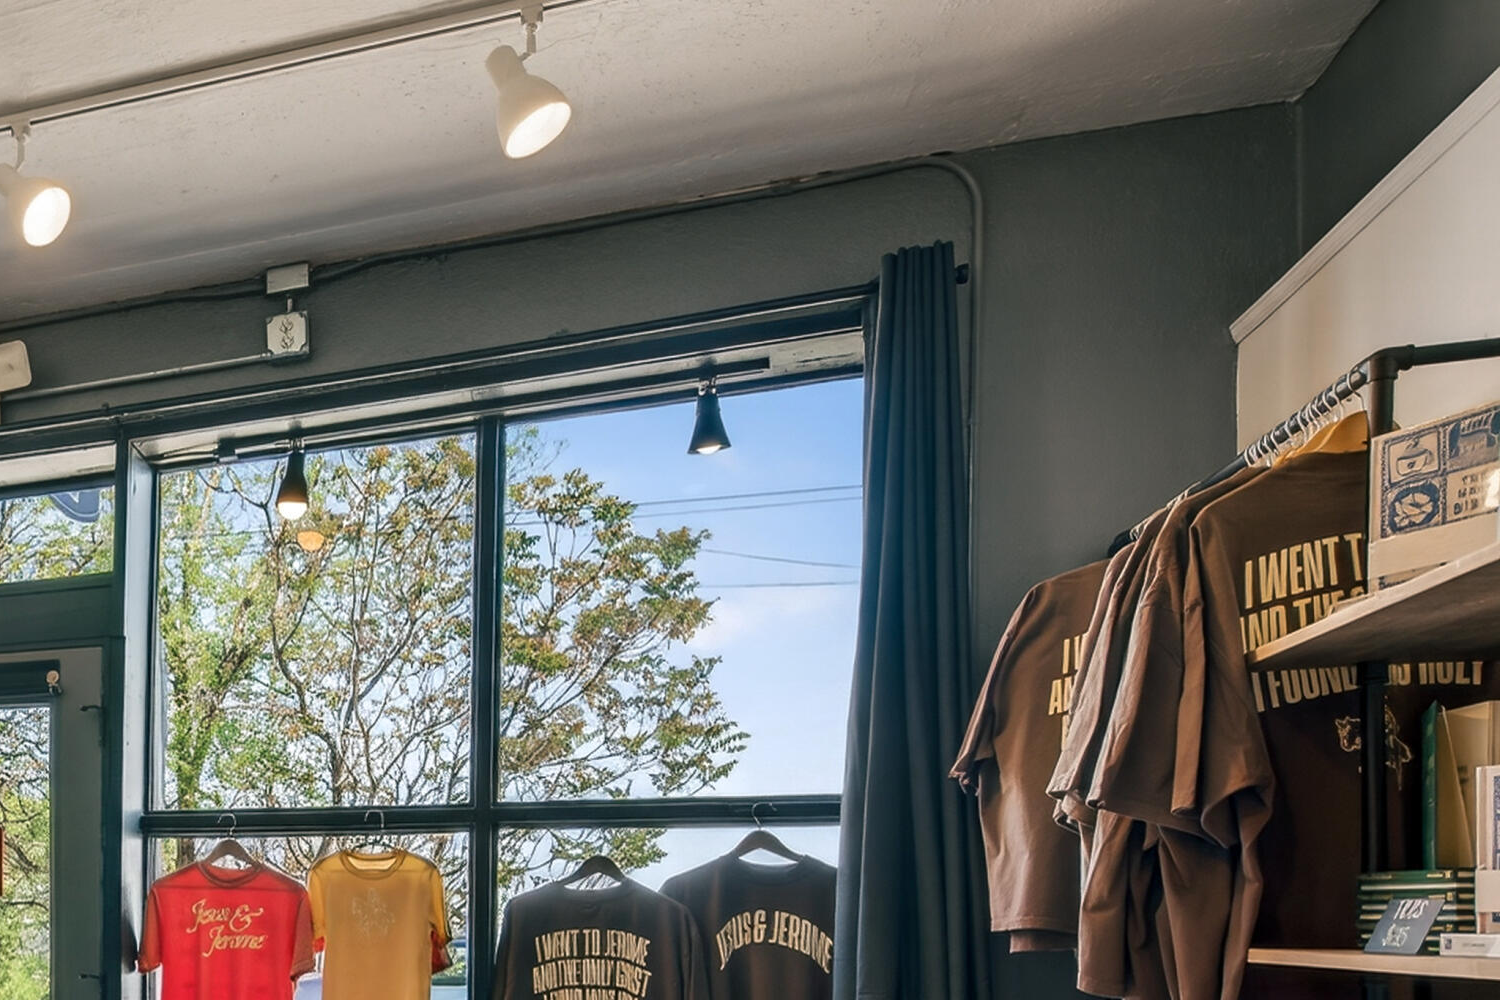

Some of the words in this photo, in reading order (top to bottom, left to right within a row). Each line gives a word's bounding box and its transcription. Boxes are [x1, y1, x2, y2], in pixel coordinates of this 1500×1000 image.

[1245, 559, 1254, 610] I
[1258, 537, 1340, 605] WENT
[228, 903, 264, 933] &
[753, 908, 767, 944] &
[768, 909, 834, 975] JEROME
[542, 929, 580, 960] WENT
[582, 928, 601, 956] TO
[605, 929, 651, 966] JEROME
